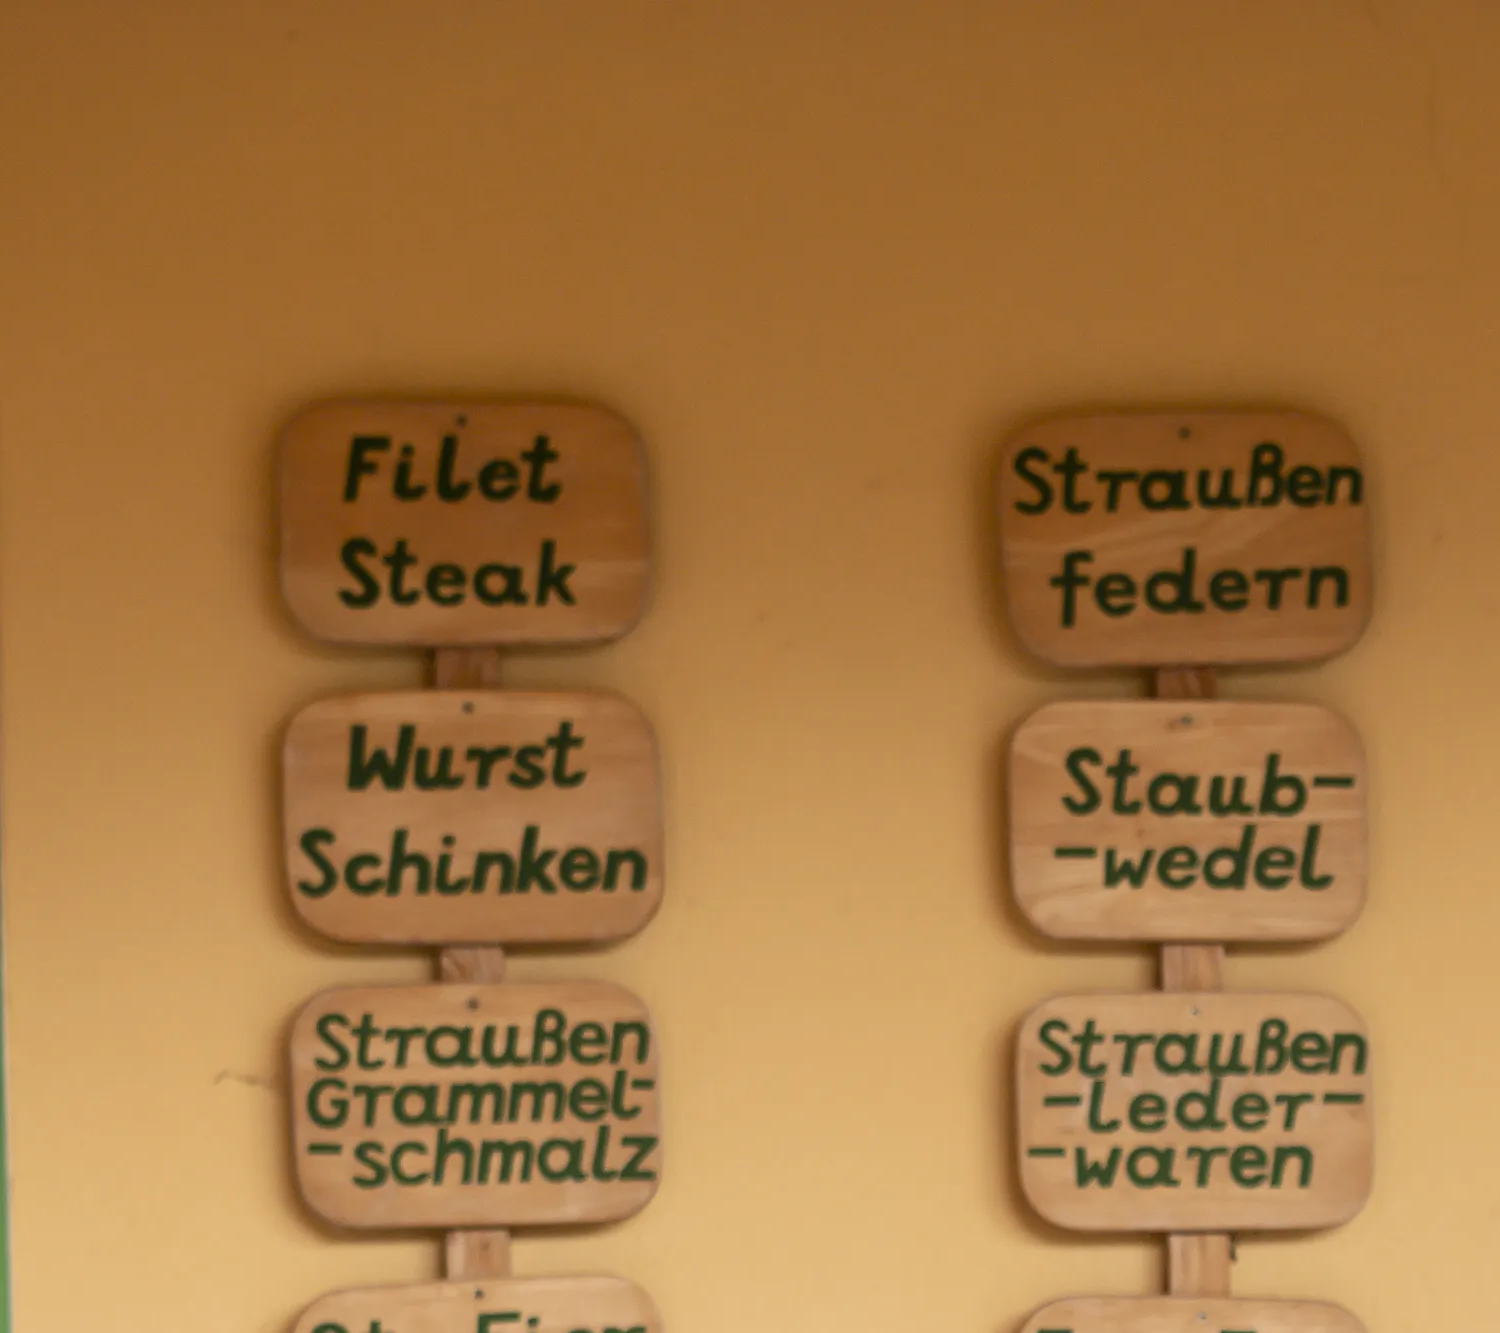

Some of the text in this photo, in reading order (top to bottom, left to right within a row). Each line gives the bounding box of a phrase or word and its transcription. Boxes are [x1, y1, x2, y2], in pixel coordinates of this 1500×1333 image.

[342, 432, 564, 504] Filet
[1012, 441, 1364, 516] Straußen
[337, 536, 578, 610] Steak
[1049, 546, 1352, 629] federn
[346, 721, 588, 792] Wurst
[1060, 746, 1356, 818] Staub-
[297, 824, 650, 899] Schinken
[1054, 824, 1334, 890] -wedel
[314, 1008, 652, 1072] Straußen
[1037, 1018, 1368, 1077] Straußen
[306, 1069, 656, 1130] Grammel-
[1042, 1078, 1366, 1133] -leder-
[306, 1124, 660, 1190] -schmalz
[1027, 1142, 1314, 1190] -waren
